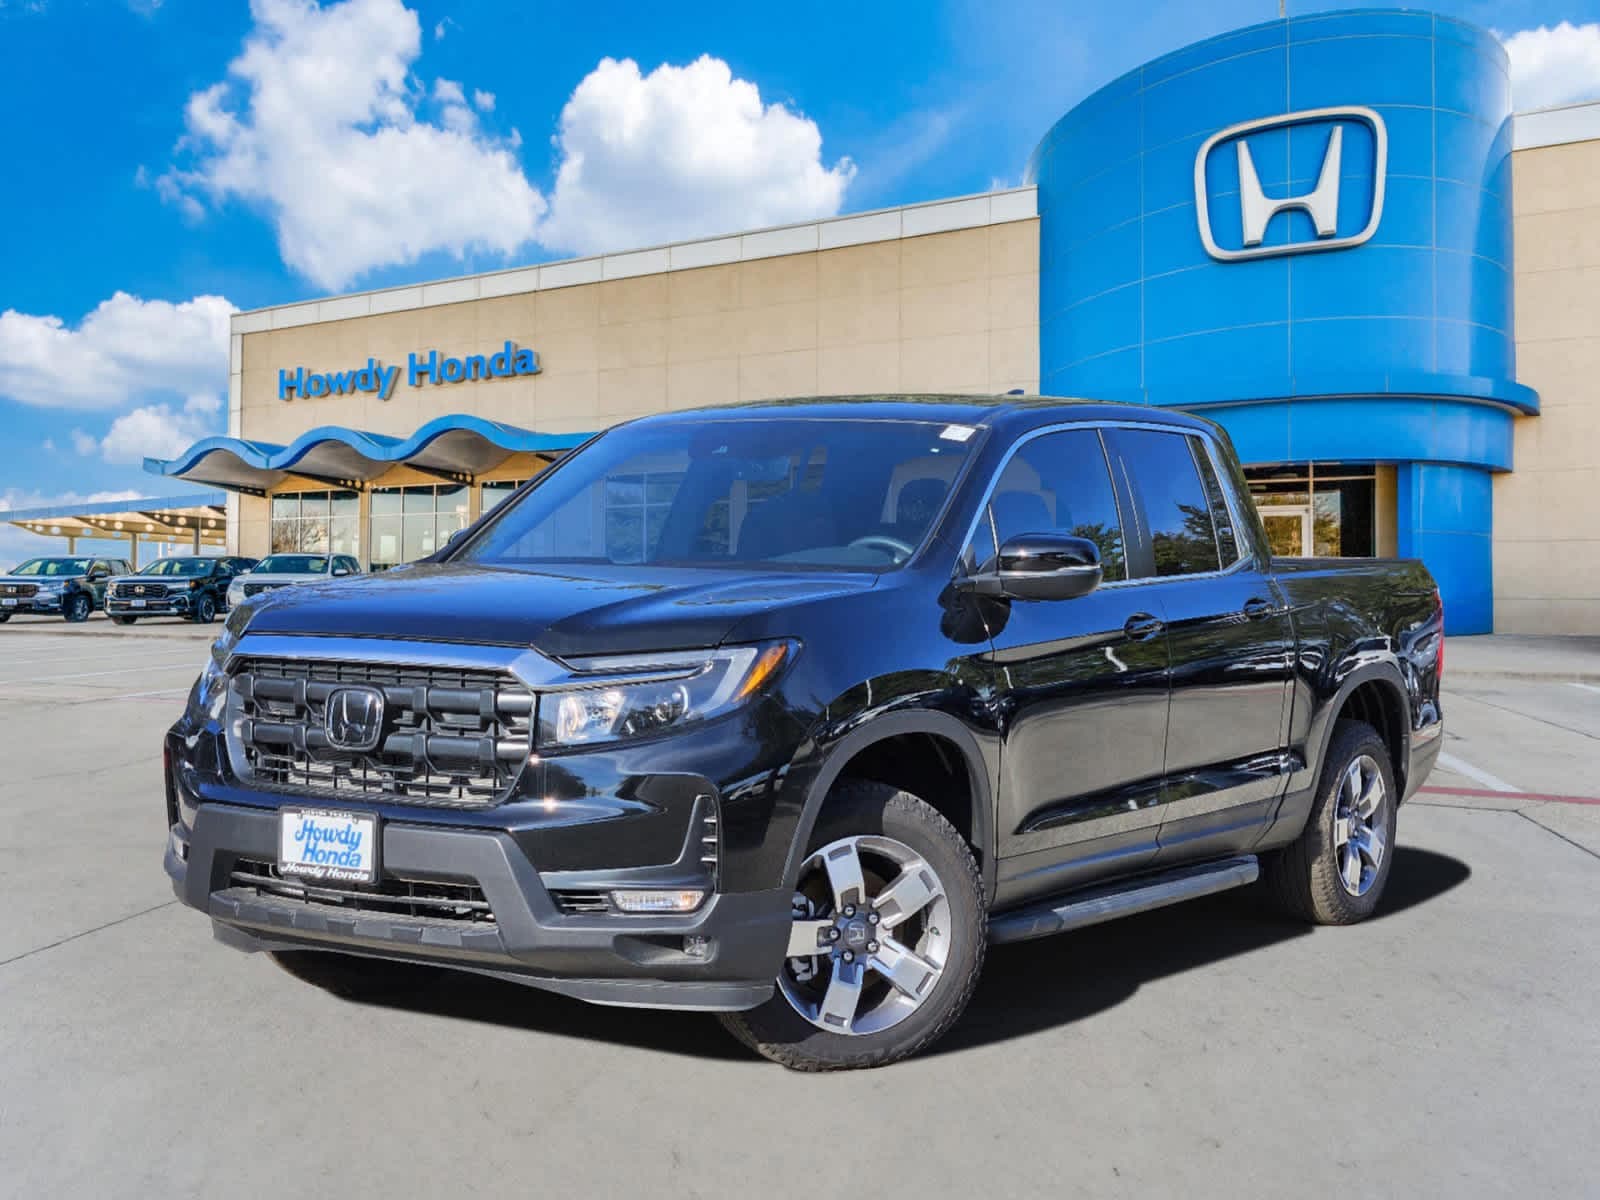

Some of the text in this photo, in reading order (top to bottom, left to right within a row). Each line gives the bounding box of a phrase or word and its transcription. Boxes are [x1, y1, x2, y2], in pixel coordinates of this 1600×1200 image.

[279, 340, 539, 400] Howdy Honda
[295, 819, 362, 851] Howdy
[302, 841, 362, 868] Honda
[281, 863, 369, 881] Howdy Honda
